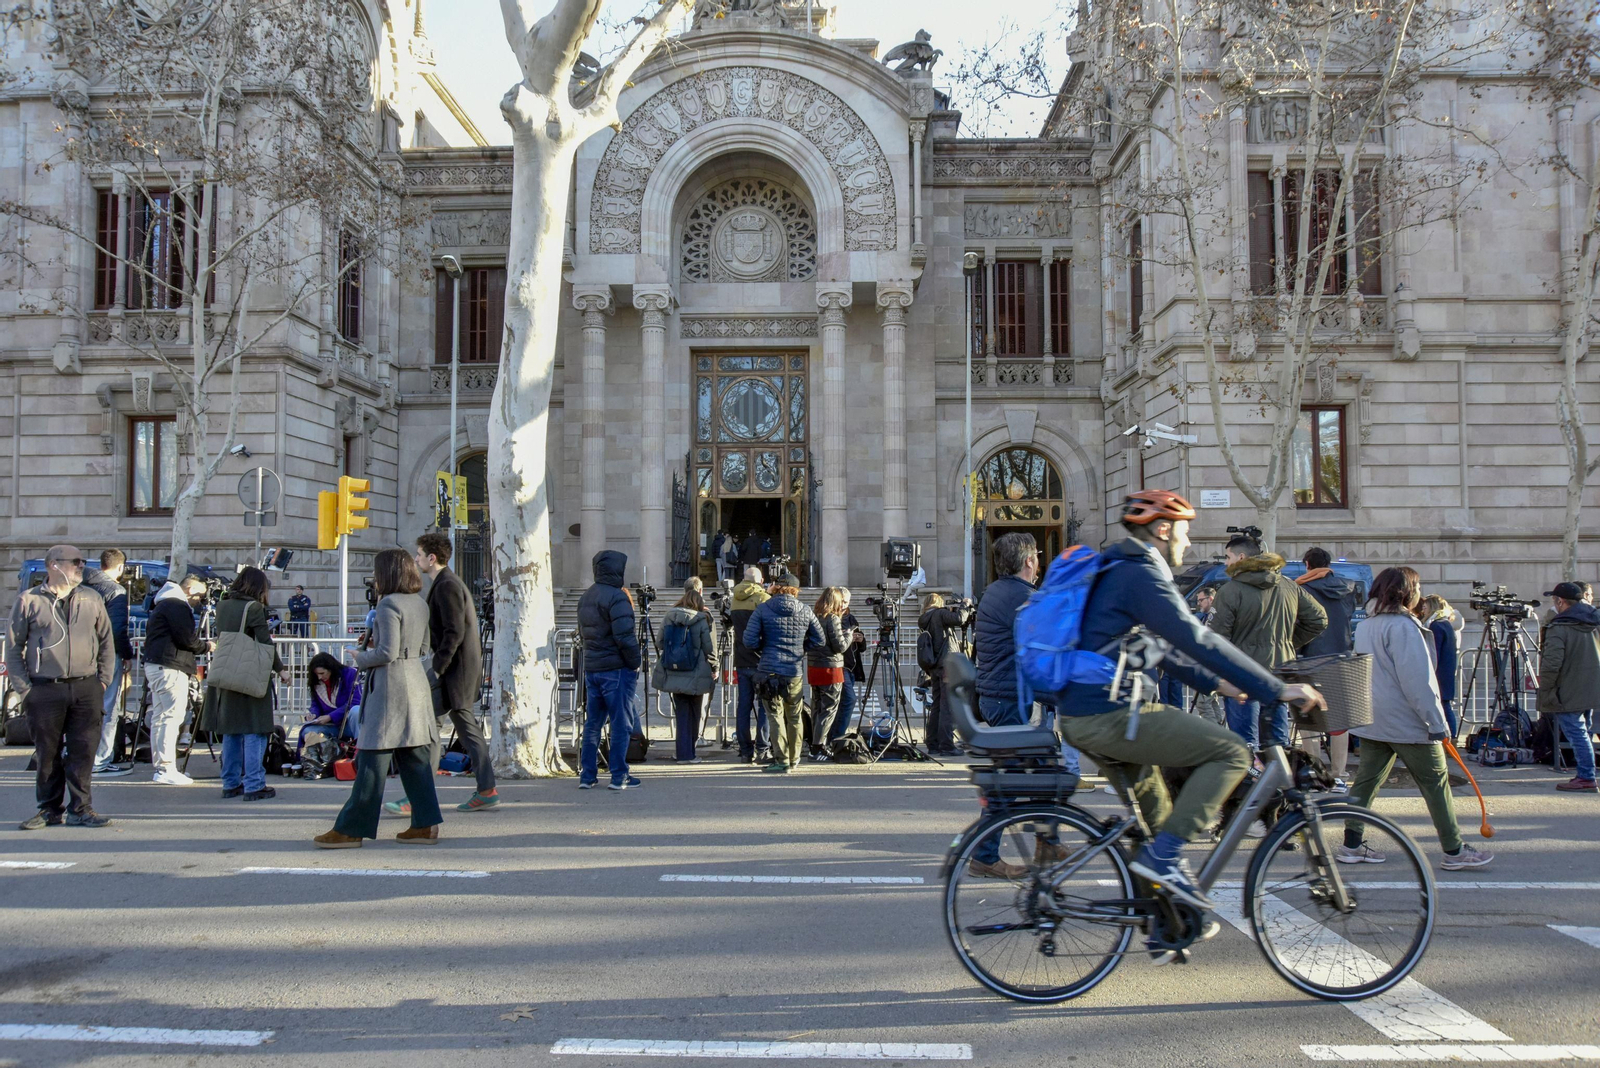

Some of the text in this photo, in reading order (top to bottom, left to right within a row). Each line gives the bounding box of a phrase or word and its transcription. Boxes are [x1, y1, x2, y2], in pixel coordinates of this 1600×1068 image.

[601, 79, 885, 248] PALACIO DE JUSTICIA
